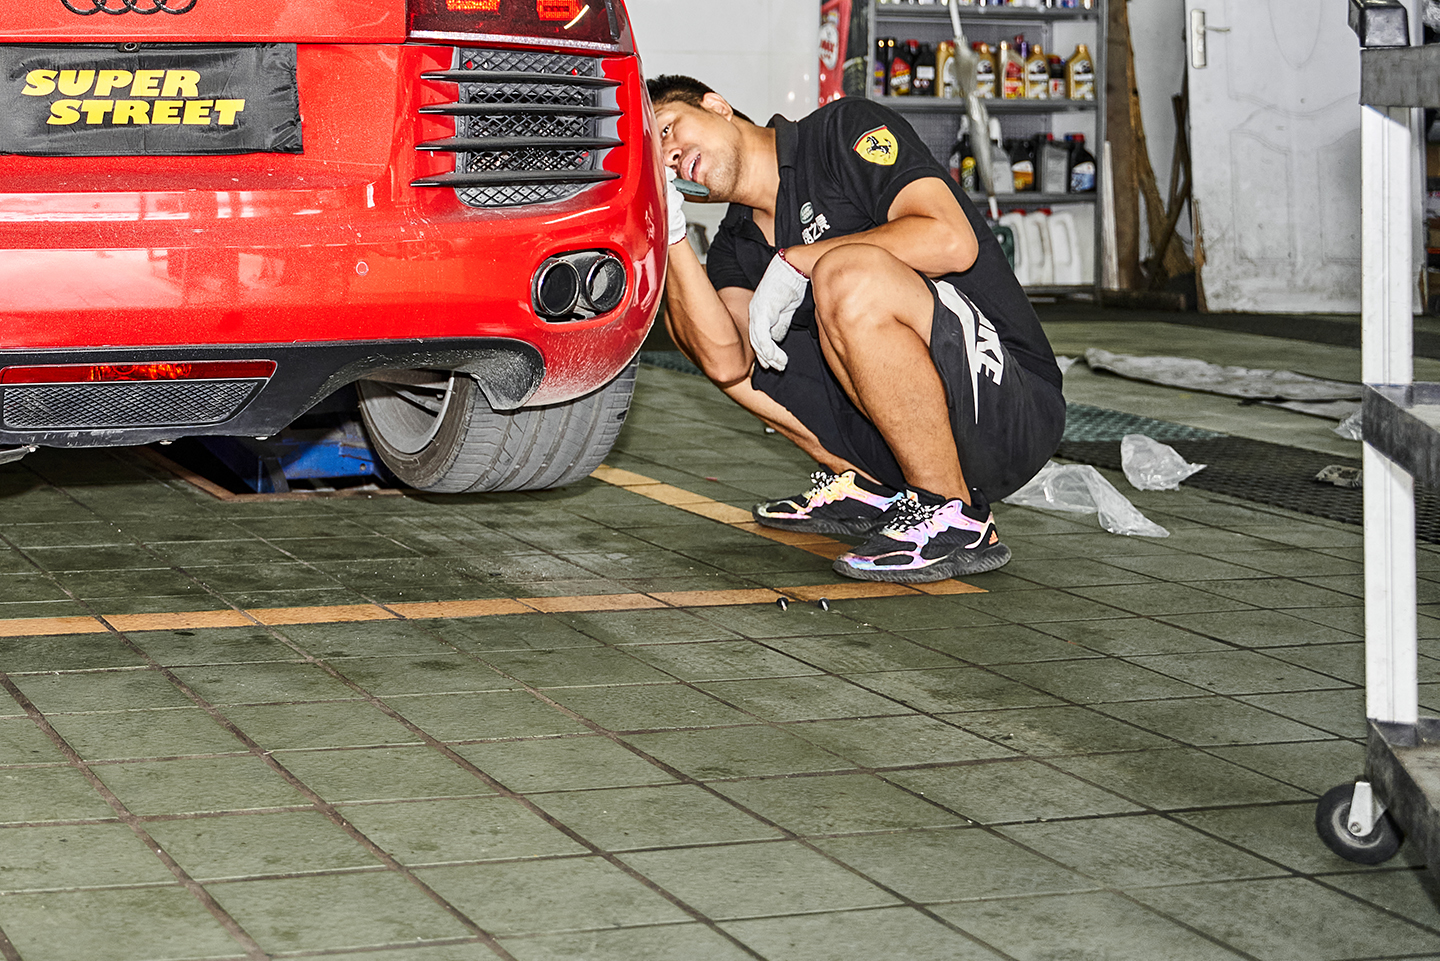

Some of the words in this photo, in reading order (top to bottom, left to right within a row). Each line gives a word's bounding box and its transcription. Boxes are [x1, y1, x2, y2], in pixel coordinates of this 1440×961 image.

[21, 69, 201, 97] SUPER
[46, 99, 245, 125] STREET
[965, 294, 1004, 386] IKE
